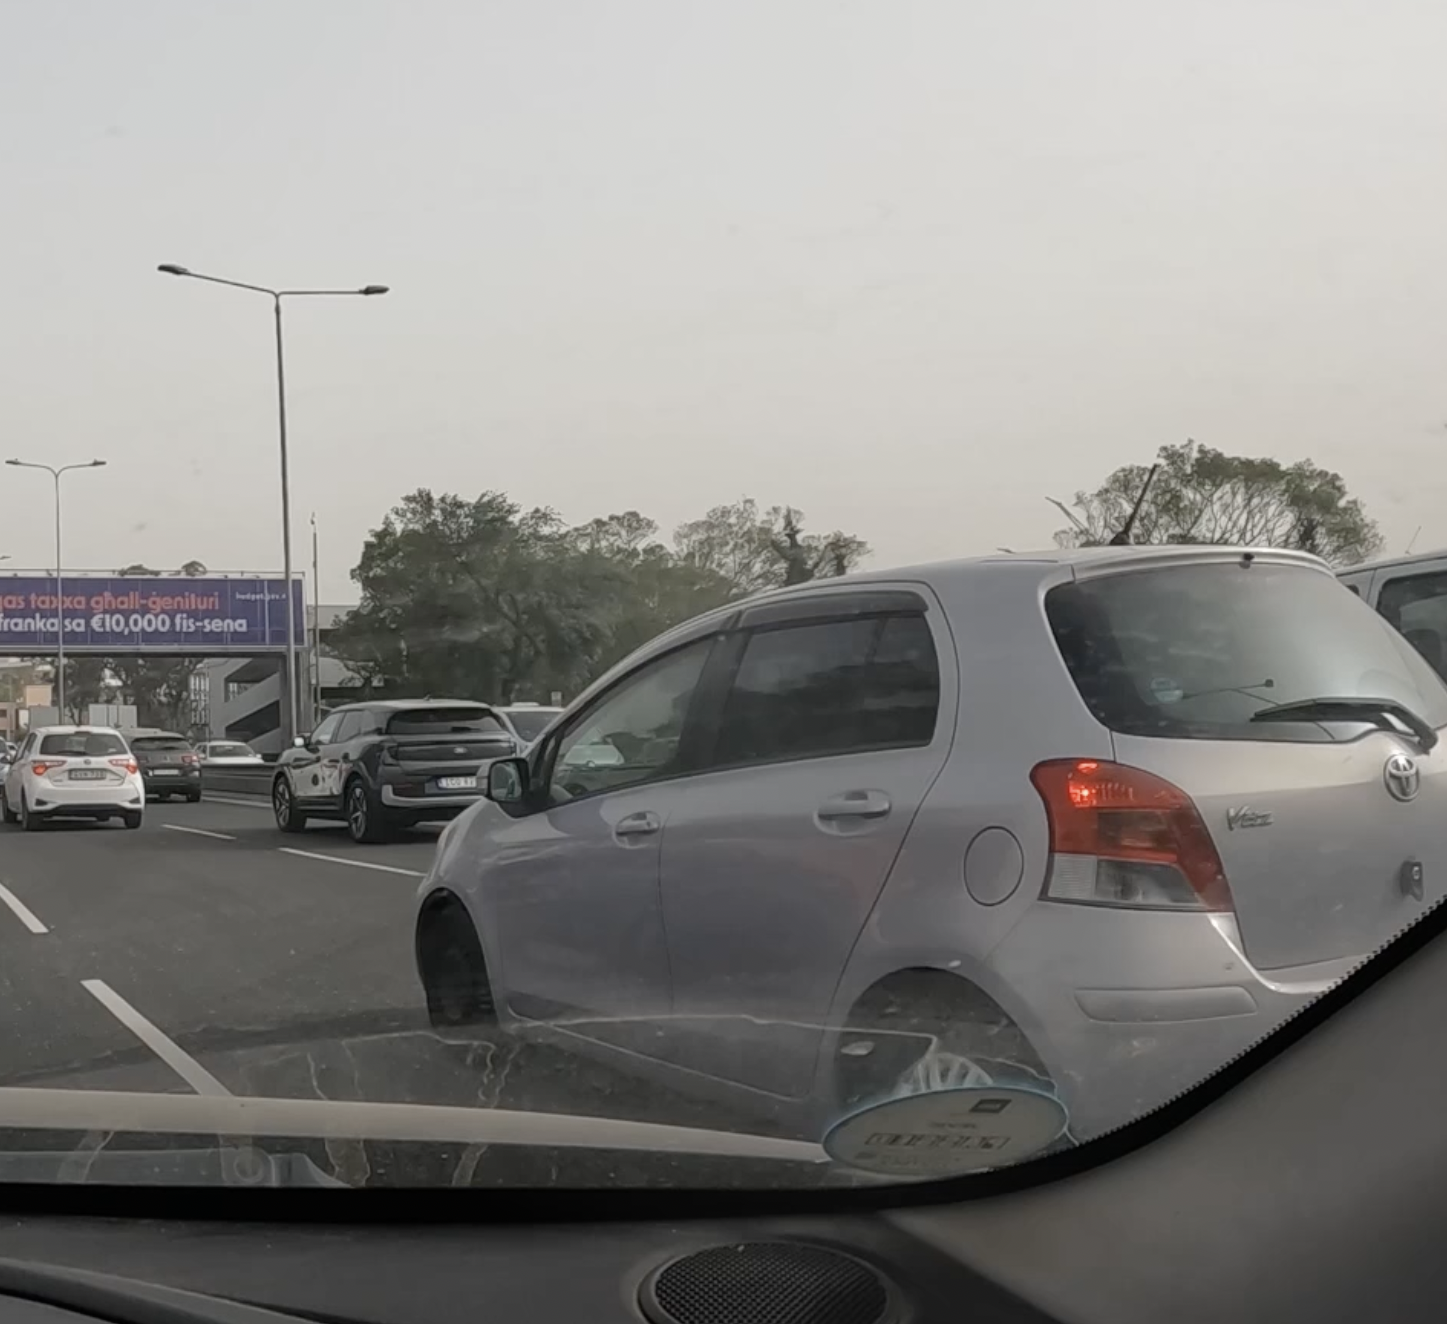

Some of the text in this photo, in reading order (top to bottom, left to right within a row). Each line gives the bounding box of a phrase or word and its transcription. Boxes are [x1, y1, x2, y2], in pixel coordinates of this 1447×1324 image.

[30, 592, 86, 609] taxxa
[64, 617, 86, 632] sa
[90, 612, 171, 635] €10,000
[174, 612, 248, 632] fis-sena
